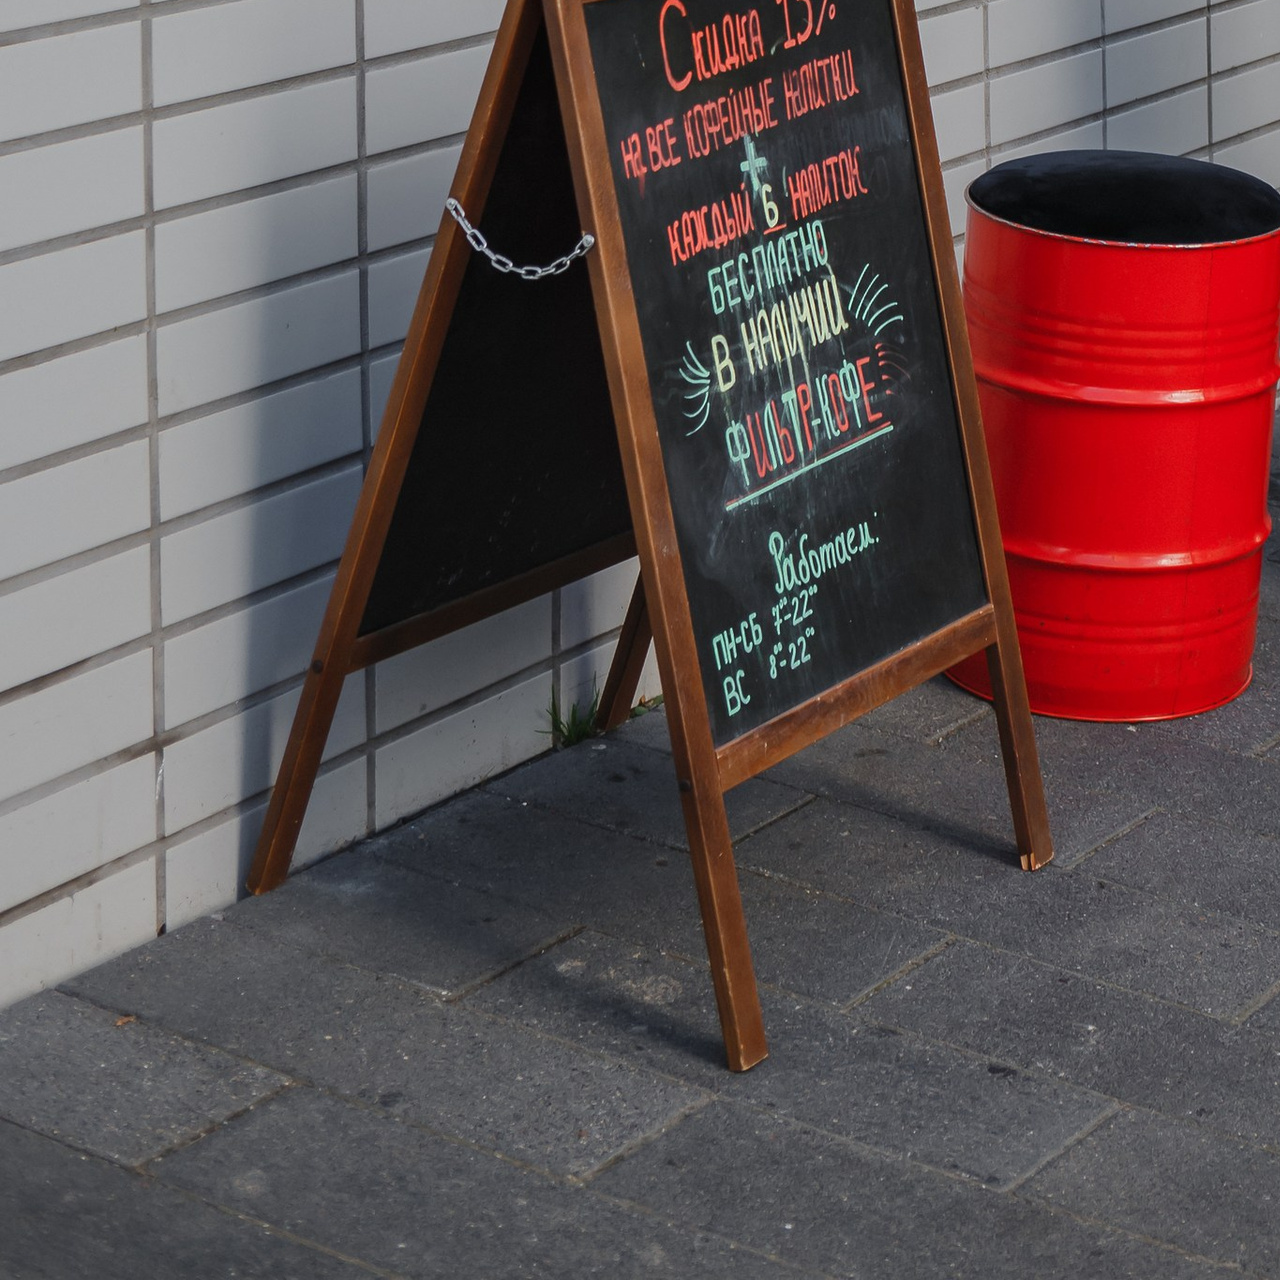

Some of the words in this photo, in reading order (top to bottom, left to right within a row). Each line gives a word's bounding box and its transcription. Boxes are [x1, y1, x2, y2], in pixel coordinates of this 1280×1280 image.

[646, 118, 682, 173] ВСЕ
[683, 78, 779, 160] КОФЕЙНЫЕ
[667, 182, 755, 266] КАЖДЫЙ
[761, 183, 779, 228] 6
[788, 145, 868, 221] НАПИТОК
[707, 220, 829, 315] БЕСПЛАТНО
[711, 334, 736, 392] В
[740, 274, 849, 375] НАЛИЧИИ
[725, 356, 883, 486] ФИЛЬТР-КОФЕ
[712, 612, 763, 671] ПН-СБ
[723, 669, 751, 717] ВС
